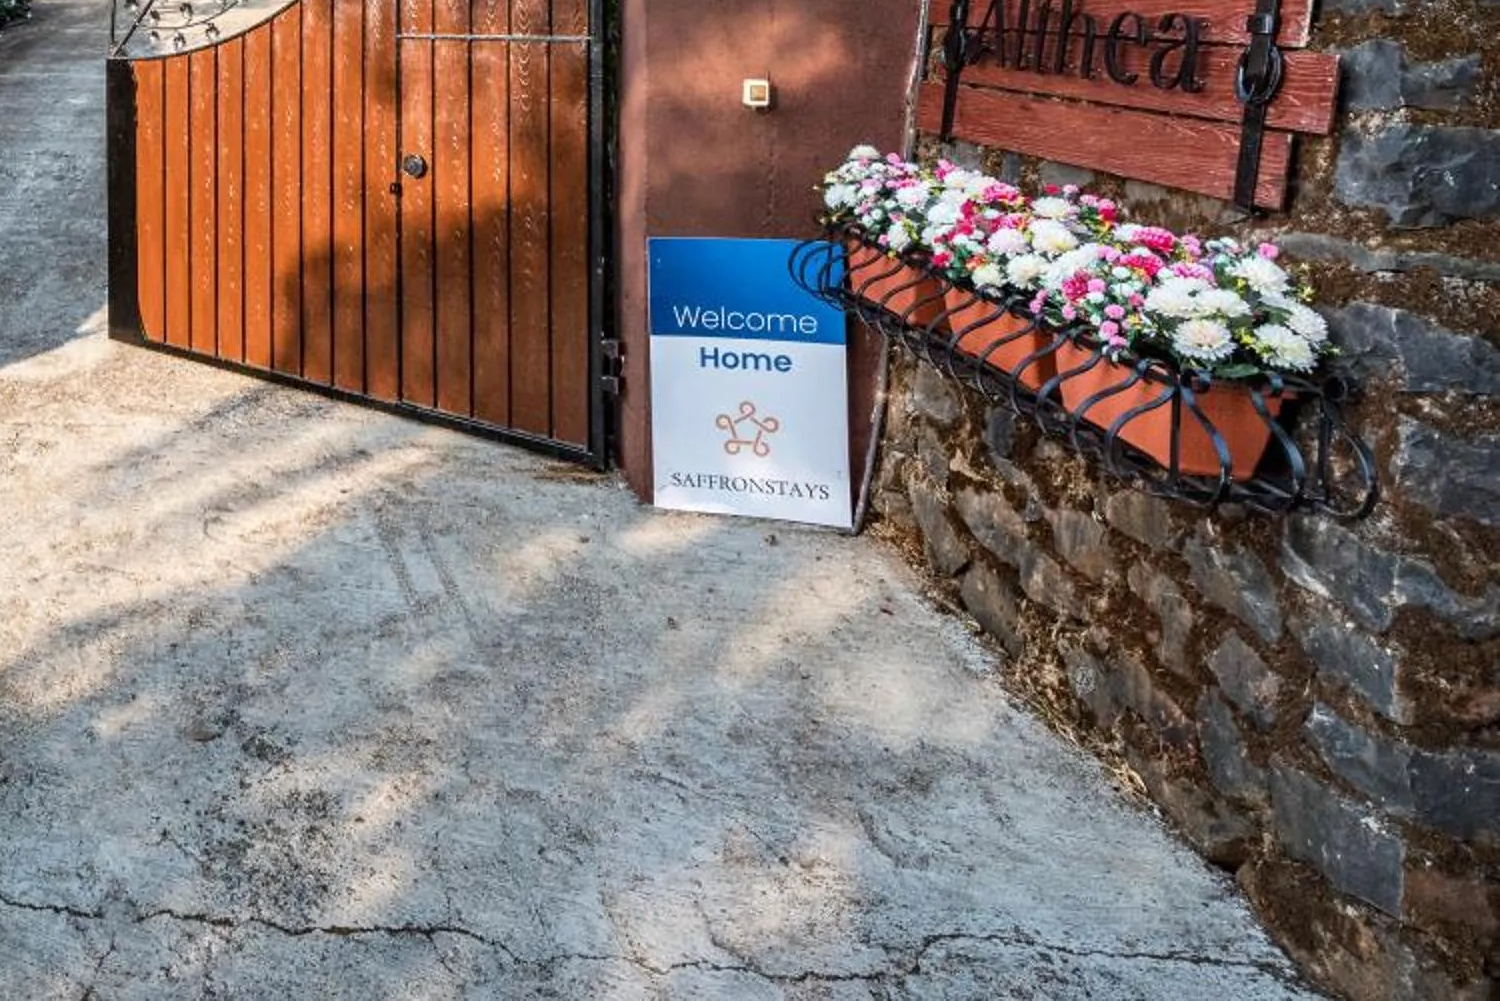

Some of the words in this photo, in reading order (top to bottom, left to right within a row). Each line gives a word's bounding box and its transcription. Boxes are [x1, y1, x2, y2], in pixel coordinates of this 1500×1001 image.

[673, 305, 818, 334] Welcome
[700, 346, 793, 372] Home
[671, 472, 830, 500] SAFFRONSTAYS
